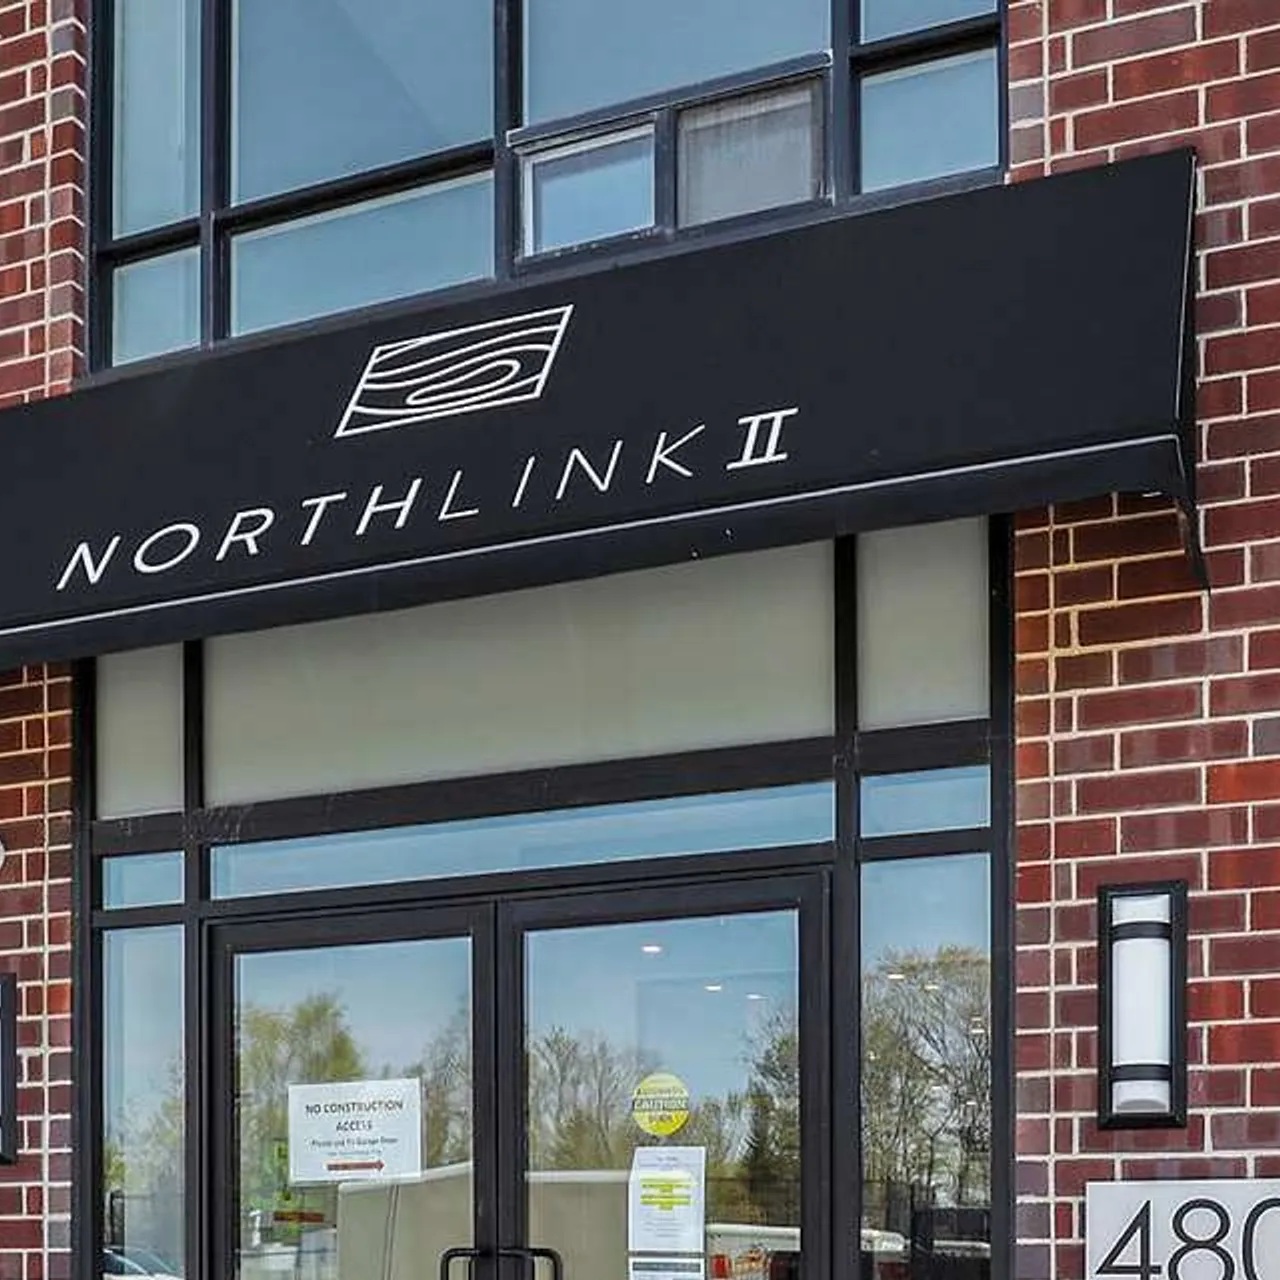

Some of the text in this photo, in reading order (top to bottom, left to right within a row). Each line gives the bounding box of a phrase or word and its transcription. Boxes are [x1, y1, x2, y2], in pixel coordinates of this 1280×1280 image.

[55, 407, 800, 592] NORTHLINK II
[305, 1099, 403, 1114] NO CONSTRUCTION
[336, 1119, 373, 1132] ACCESS
